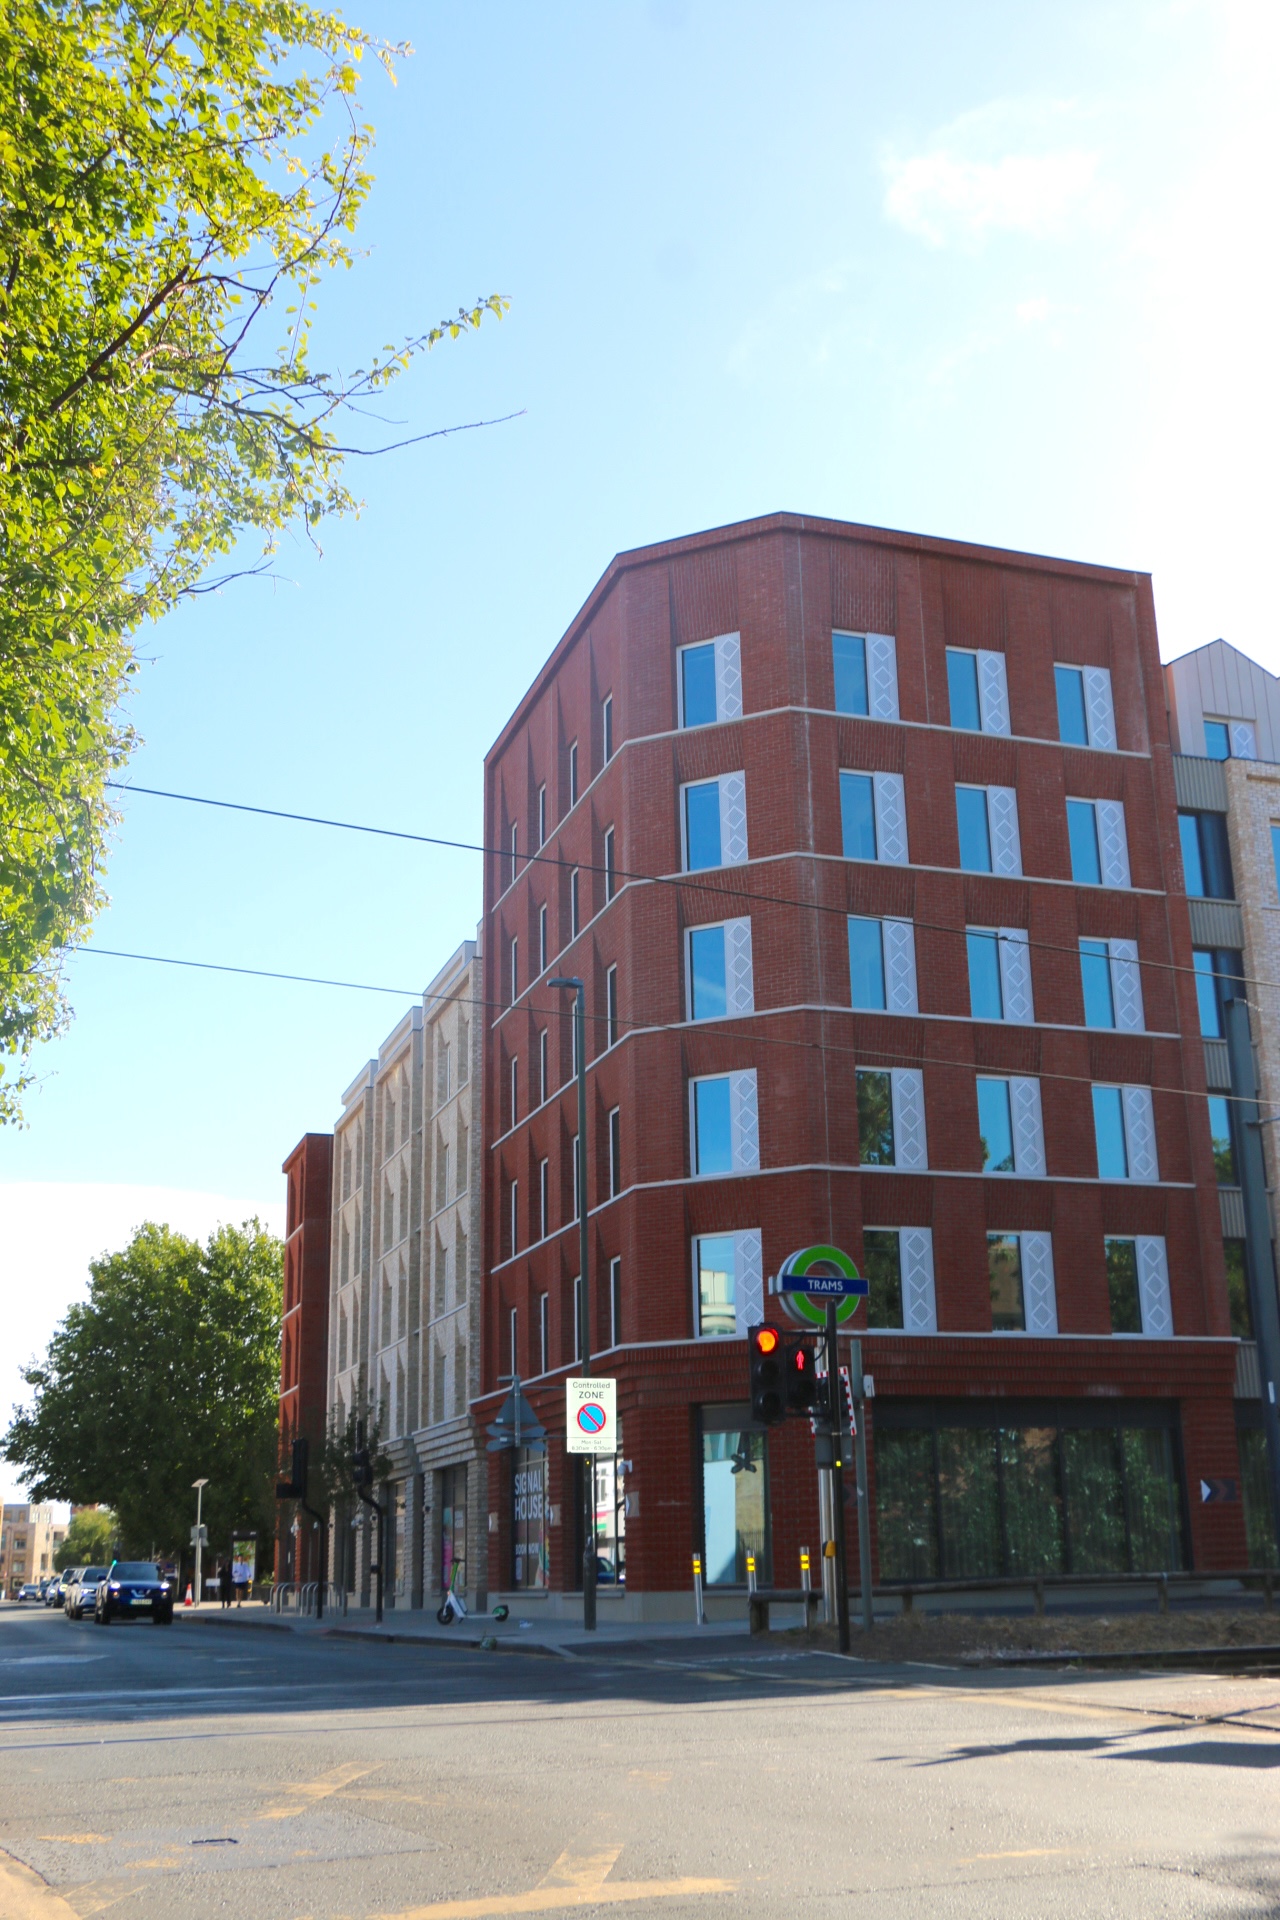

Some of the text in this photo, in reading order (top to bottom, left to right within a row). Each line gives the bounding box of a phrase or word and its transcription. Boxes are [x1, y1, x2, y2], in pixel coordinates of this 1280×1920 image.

[808, 1279, 844, 1292] TRAMS
[572, 1381, 611, 1389] Controlled
[578, 1391, 604, 1399] ZONE
[514, 1469, 543, 1495] SIGNAL
[514, 1494, 543, 1520] HOUSE
